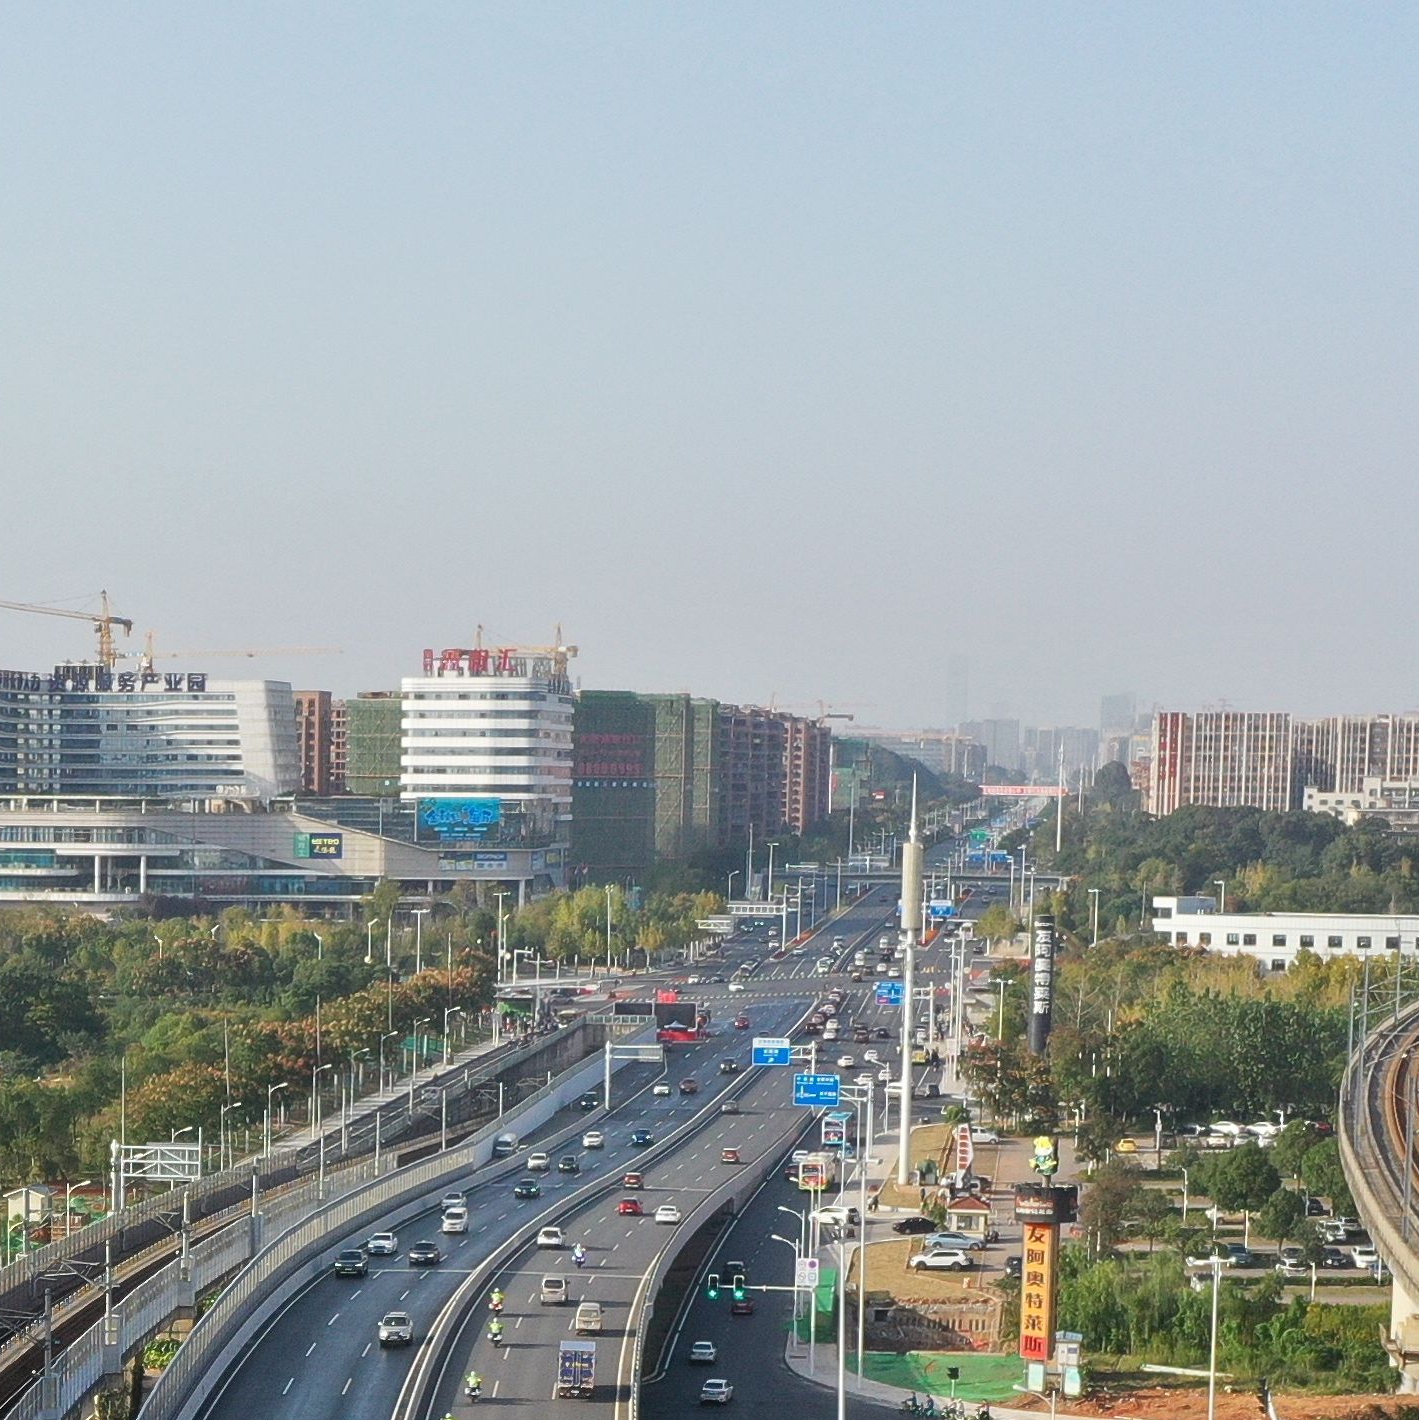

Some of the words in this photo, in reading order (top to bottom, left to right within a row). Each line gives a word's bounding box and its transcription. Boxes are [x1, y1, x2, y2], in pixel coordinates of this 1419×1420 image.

[1024, 1226, 1046, 1353] 友阿奥特莱斯
